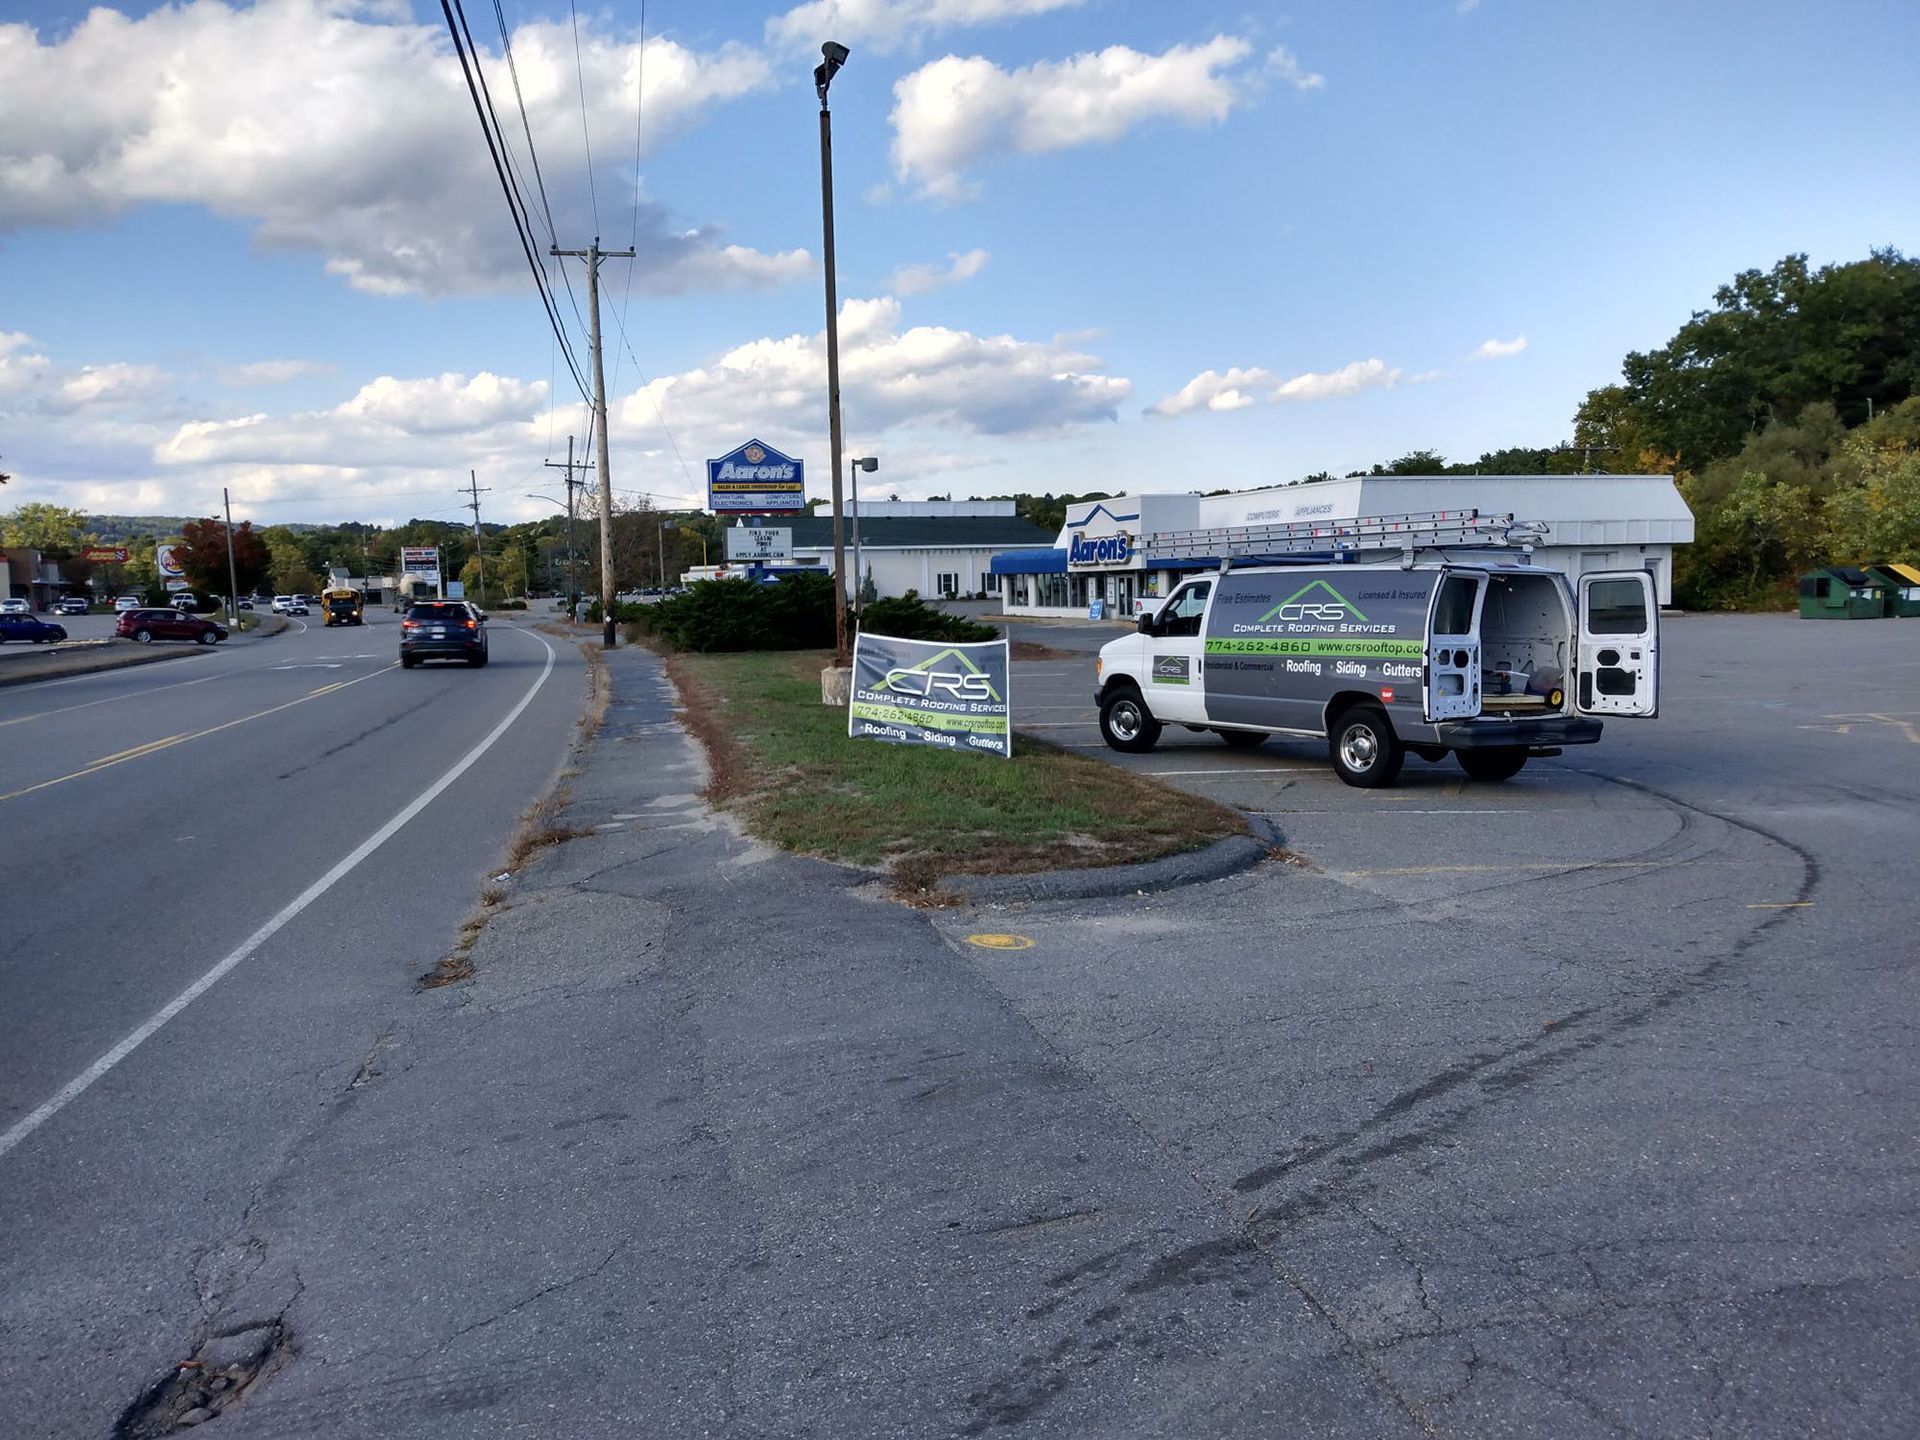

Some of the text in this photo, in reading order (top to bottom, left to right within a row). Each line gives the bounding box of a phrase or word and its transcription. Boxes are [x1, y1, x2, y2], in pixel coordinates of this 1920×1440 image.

[717, 462, 794, 480] Aaron's
[1247, 505, 1333, 520] COMPUTERS APPLIANCES
[1069, 533, 1128, 563] Aaron's
[1217, 592, 1271, 604] Free Estimates
[1358, 590, 1389, 600] Licensed
[1400, 590, 1427, 599] Insured
[1279, 604, 1346, 620] CRS
[1233, 623, 1396, 633] COMPLETE ROOFING SERVICES
[1318, 642, 1423, 655] www.crsrooftop.co
[1286, 659, 1422, 677] Roofing Siding Gutters
[886, 668, 991, 700] CRS
[857, 690, 1006, 713] COMPLETE ROOFING SERVICES
[864, 723, 1003, 749] Roofing Siding Gutters
